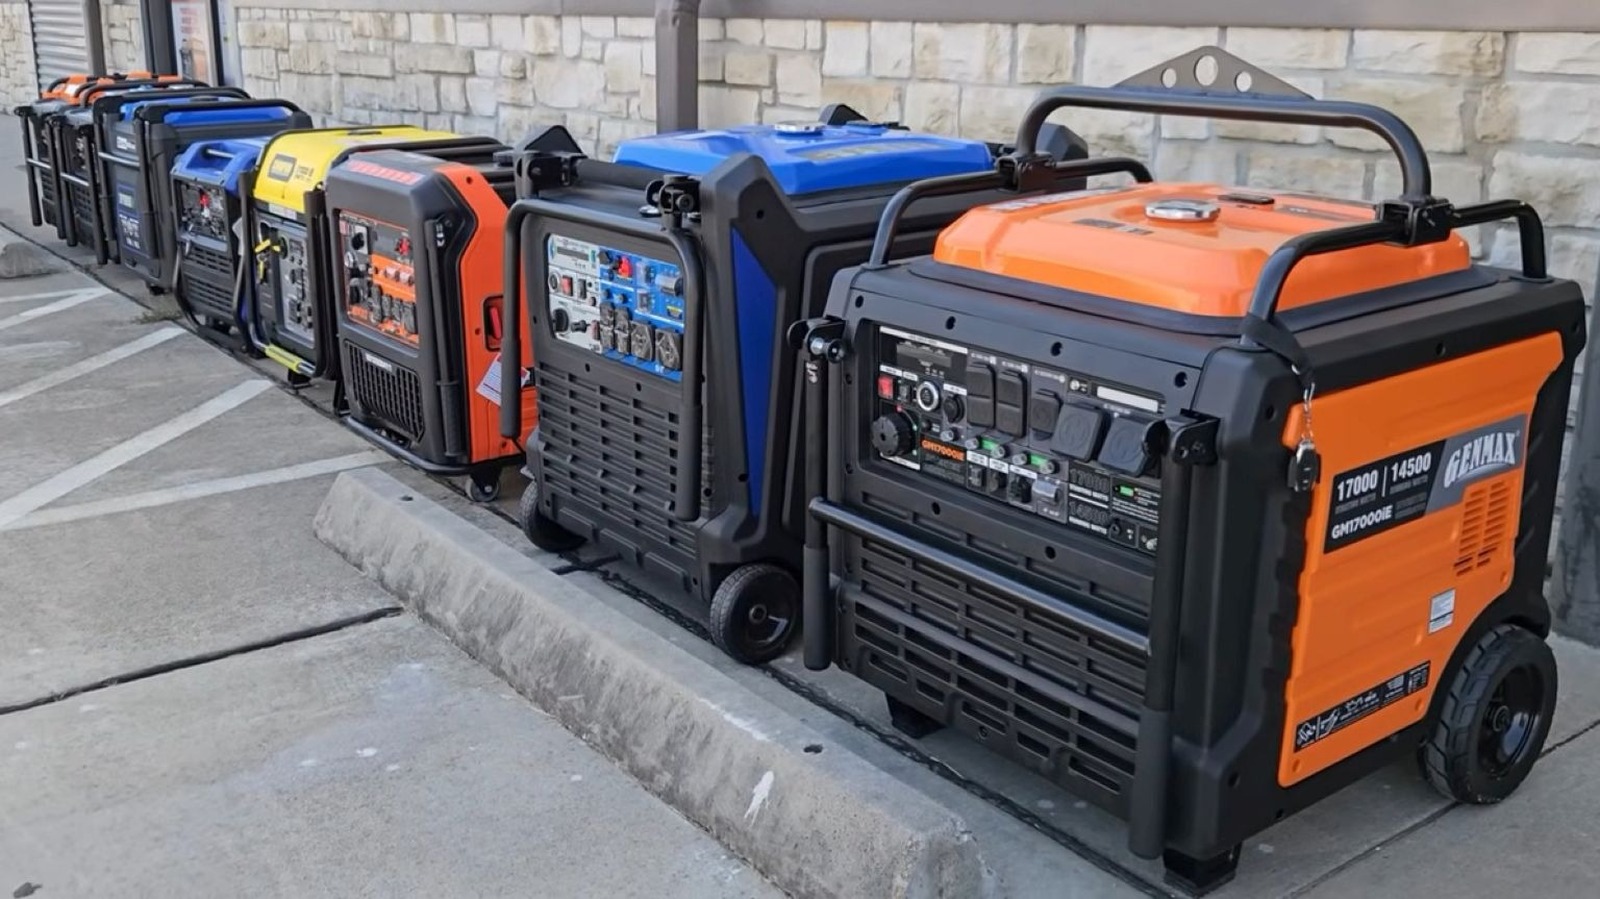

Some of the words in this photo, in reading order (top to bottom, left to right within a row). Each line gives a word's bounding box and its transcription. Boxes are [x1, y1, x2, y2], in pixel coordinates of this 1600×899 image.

[1337, 469, 1379, 502] 17000
[1391, 452, 1432, 482] 14500
[1443, 431, 1516, 488] GENMAX
